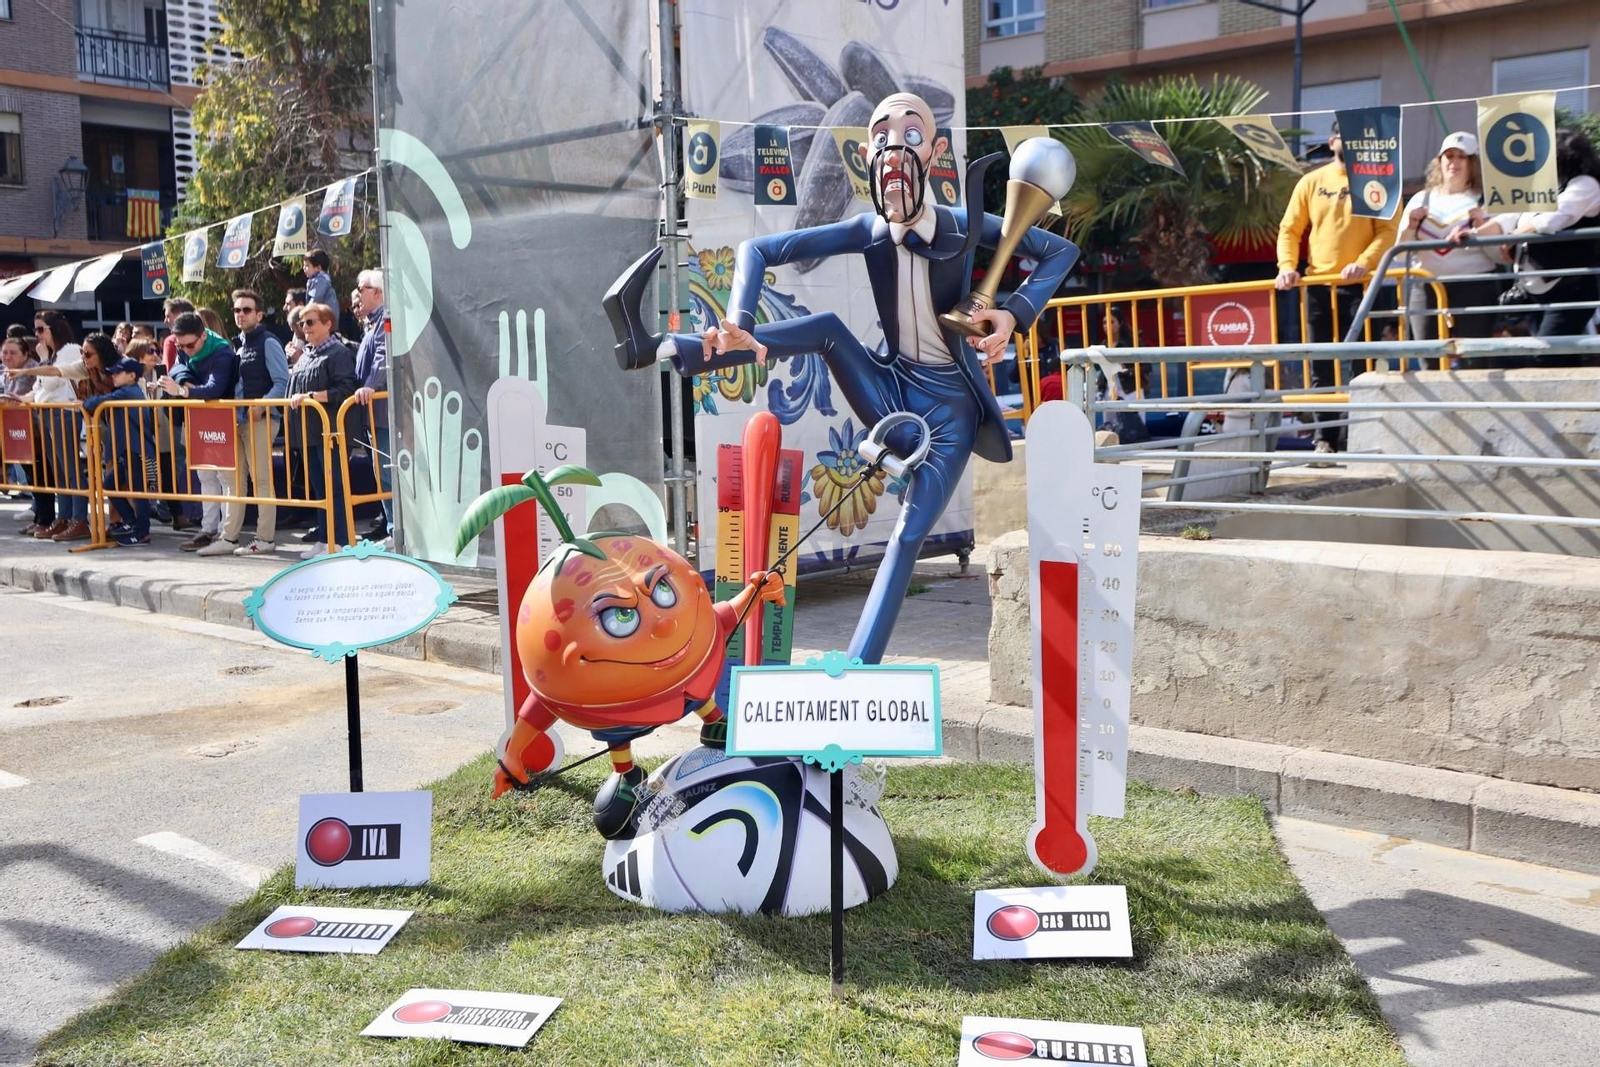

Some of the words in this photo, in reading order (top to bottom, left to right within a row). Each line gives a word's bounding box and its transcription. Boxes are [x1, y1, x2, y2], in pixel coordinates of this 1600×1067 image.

[1363, 127, 1376, 138] LA
[770, 139, 778, 147] LA
[1345, 137, 1397, 151] TELEVISIÓ
[757, 147, 789, 157] TELEVISIÓ
[1356, 151, 1370, 162] DE
[1371, 151, 1389, 162] LES
[763, 157, 774, 165] DE
[1353, 163, 1395, 176] FALLES
[692, 182, 717, 195] Punt
[1487, 186, 1505, 207] À
[1510, 188, 1557, 205] Punt
[283, 241, 306, 250] Punt
[203, 431, 227, 442] AMBAR
[557, 486, 573, 498] 50
[1103, 543, 1121, 557] 50
[717, 575, 728, 583] 20
[1102, 576, 1120, 590] 40
[772, 604, 784, 653] TEMPLAD
[744, 700, 859, 723] CALENTAMENT
[866, 699, 929, 722] GLOBAL
[1097, 750, 1114, 761] 20
[362, 828, 388, 857] IVA
[1042, 914, 1064, 929] CAS
[1072, 913, 1108, 928] KOLDO
[310, 923, 389, 939] EURIBOR
[1036, 1040, 1132, 1065] GUERRES
